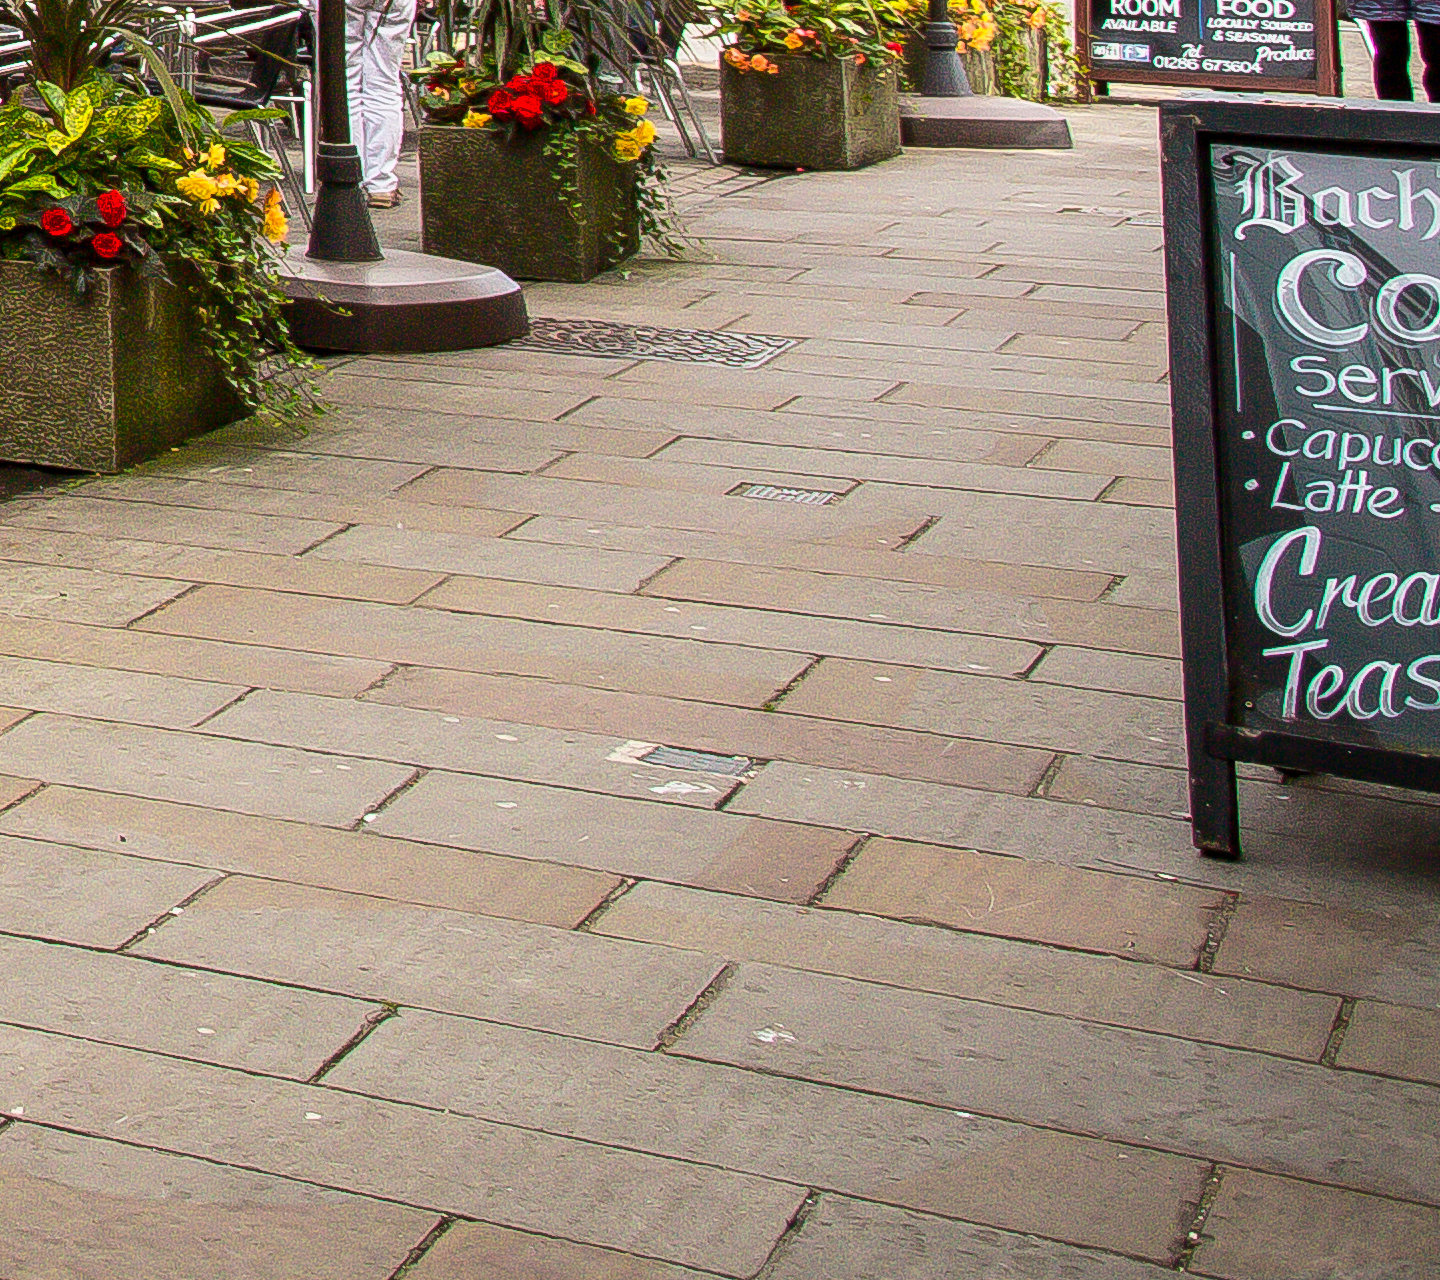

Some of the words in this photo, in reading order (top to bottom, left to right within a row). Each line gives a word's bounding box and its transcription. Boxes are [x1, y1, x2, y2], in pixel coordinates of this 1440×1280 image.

[1101, 19, 1178, 34] AVAILABLE
[1207, 17, 1259, 30] LOCALLY
[1260, 20, 1314, 32] SOURCED
[1212, 30, 1223, 42] &
[1224, 31, 1293, 45] SEASONAL
[1256, 45, 1316, 63] Produce
[1153, 55, 1199, 71] 01286
[1202, 58, 1263, 74] 673604
[1266, 419, 1440, 470] Capuc
[1271, 461, 1405, 518] Latte
